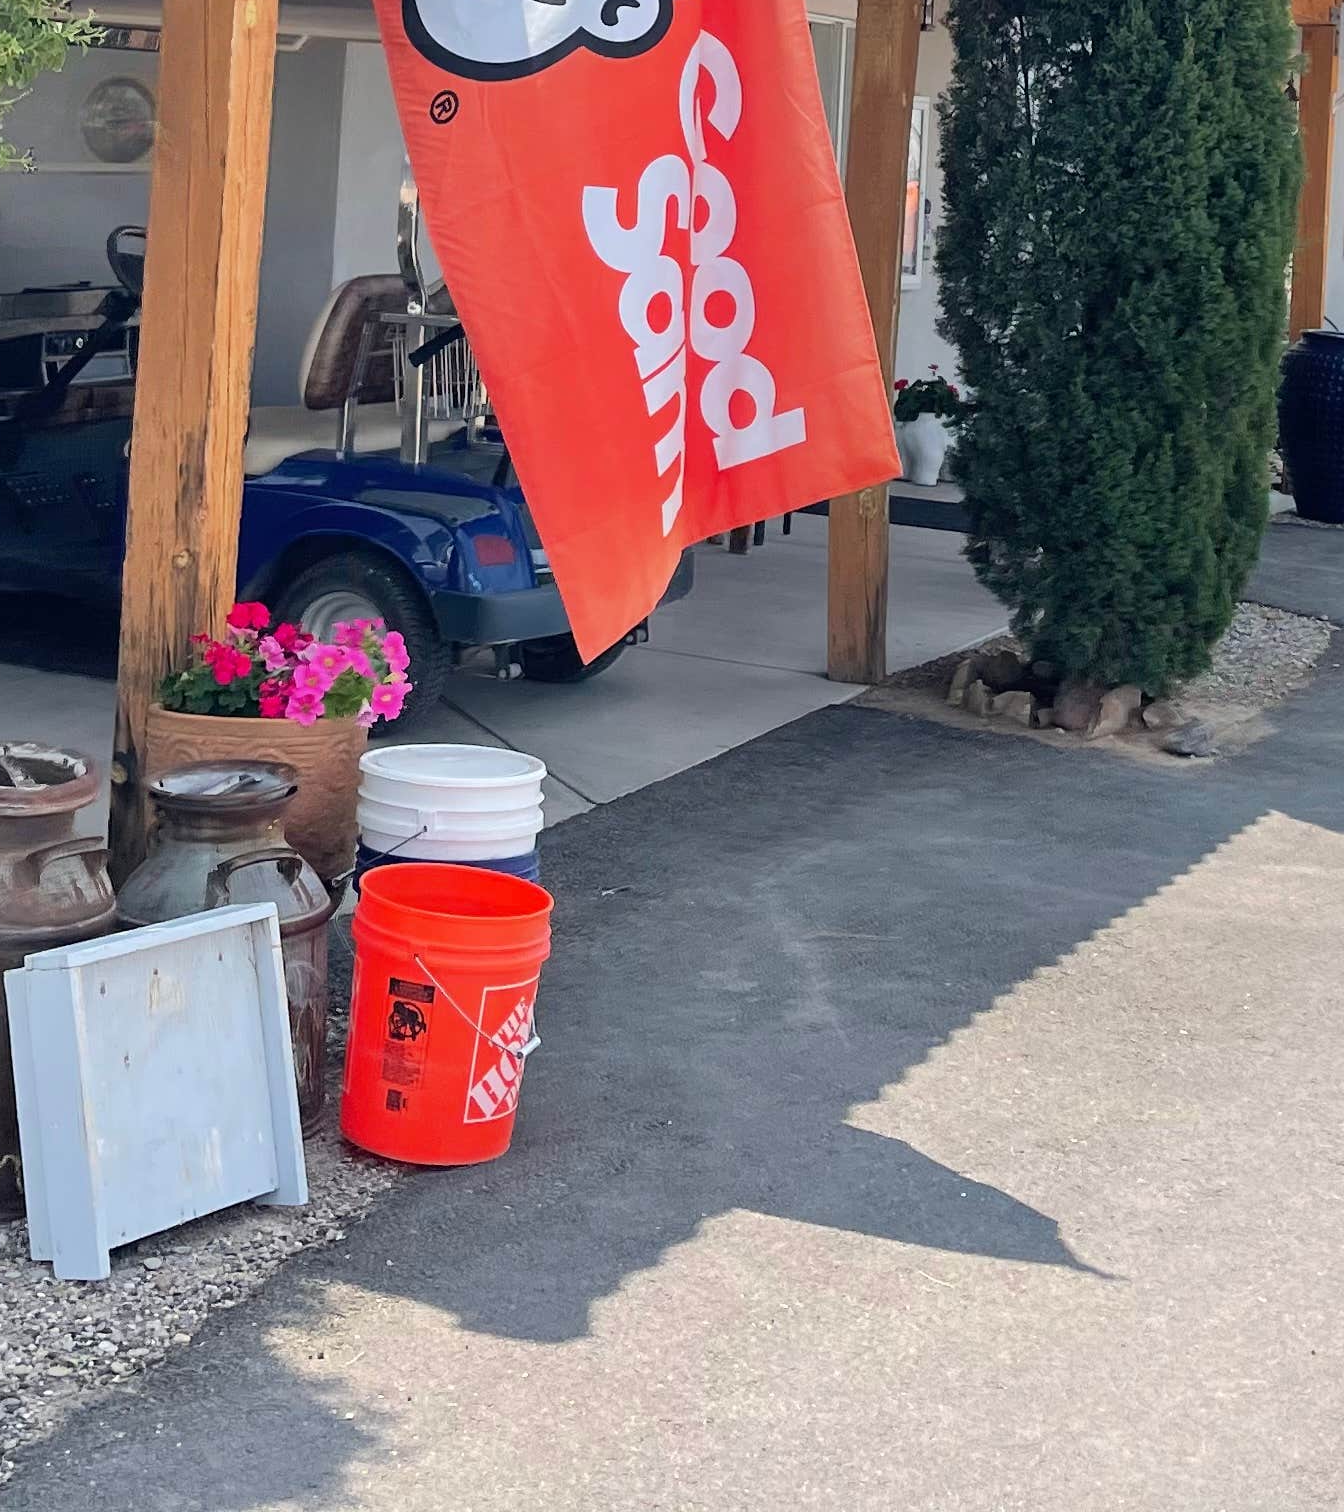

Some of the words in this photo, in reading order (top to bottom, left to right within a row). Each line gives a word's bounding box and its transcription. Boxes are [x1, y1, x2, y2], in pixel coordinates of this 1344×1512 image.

[582, 154, 690, 537] Sam
[679, 29, 806, 470] Good
[488, 997, 529, 1053] THE
